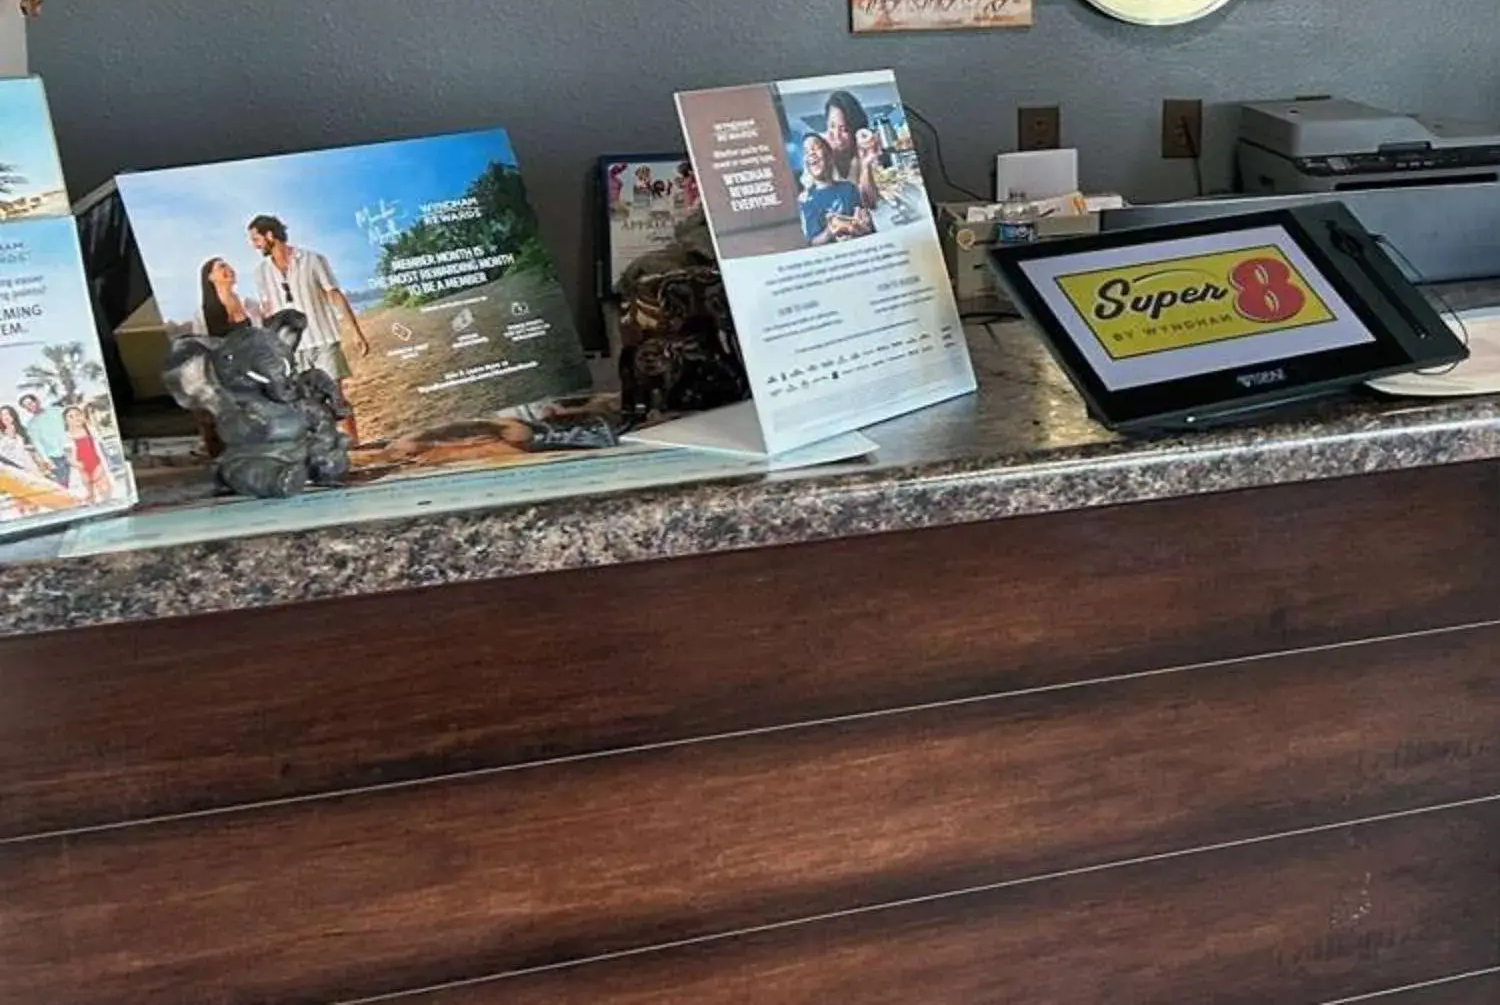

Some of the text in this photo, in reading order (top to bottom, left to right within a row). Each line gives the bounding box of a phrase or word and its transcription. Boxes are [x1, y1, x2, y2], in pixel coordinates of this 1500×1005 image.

[1094, 257, 1308, 324] Super 8
[0, 304, 42, 321] MING
[1113, 313, 1233, 342] BY WYNDHAM
